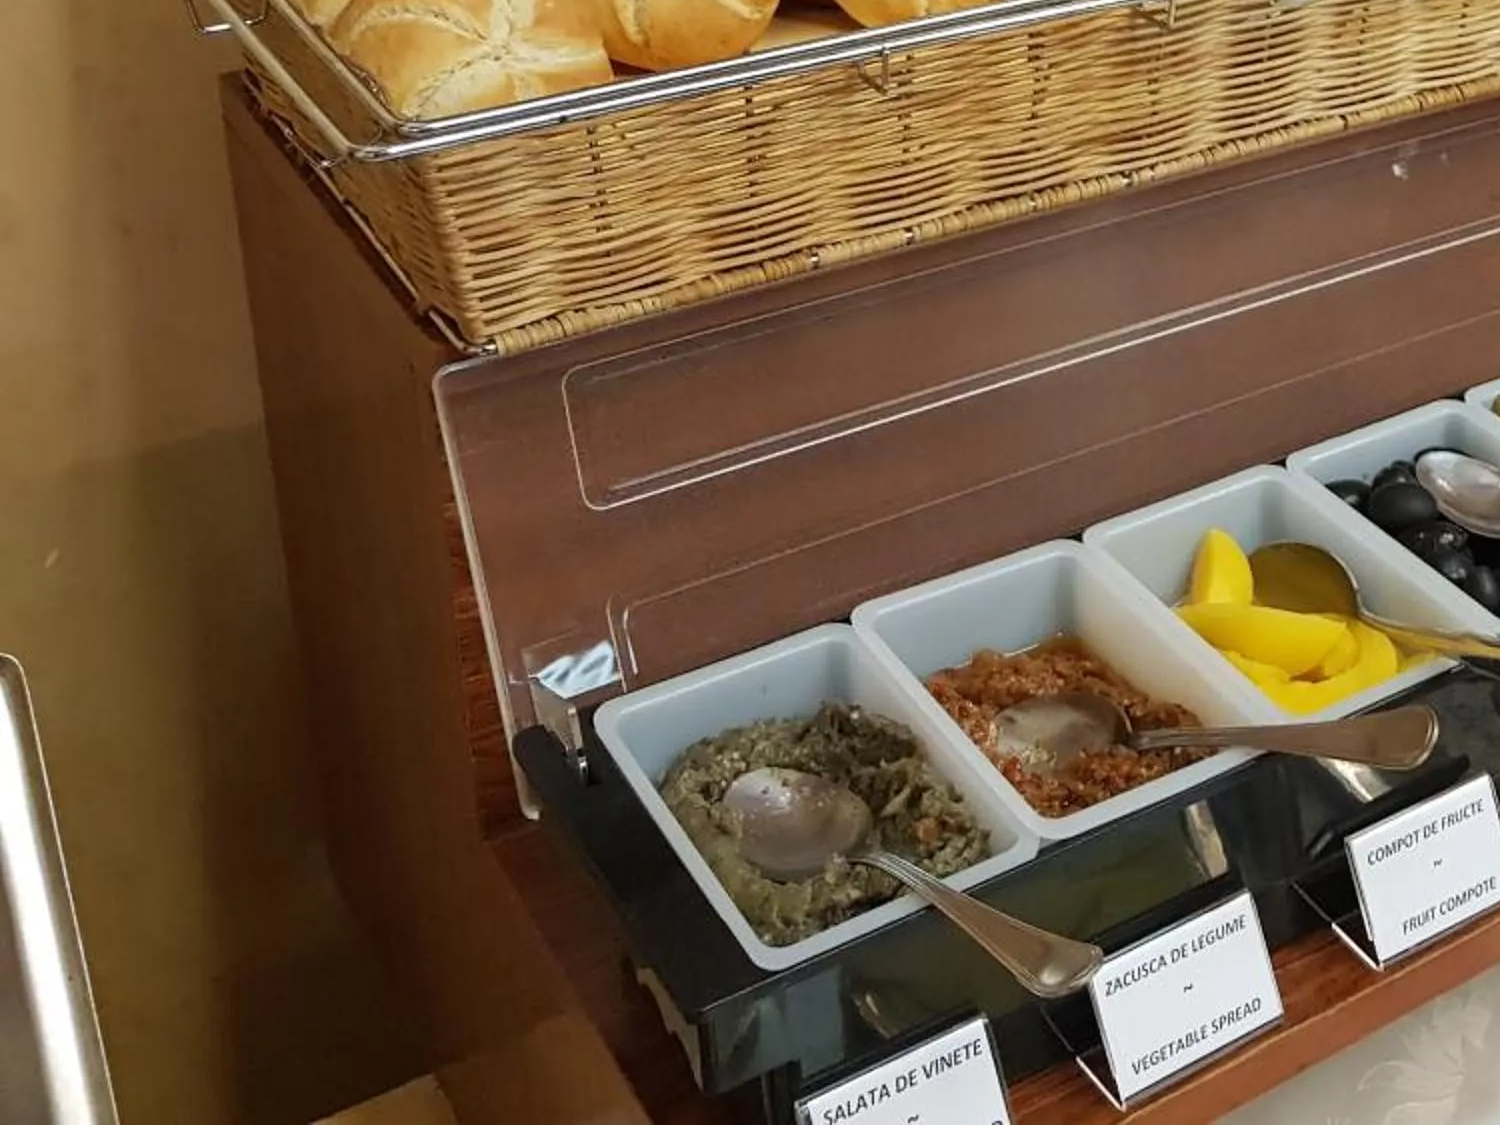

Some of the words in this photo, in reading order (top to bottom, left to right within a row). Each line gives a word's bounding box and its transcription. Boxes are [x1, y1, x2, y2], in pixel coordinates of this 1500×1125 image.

[1367, 830, 1421, 866] COMPOT
[1423, 821, 1440, 840] DE
[1441, 798, 1484, 831] FRUCTE
[1402, 906, 1437, 935] FRUIT
[1439, 876, 1497, 915] COMPOTE
[1105, 955, 1167, 996] ZACUSCA
[1171, 943, 1188, 963] DE
[1191, 914, 1247, 952] LEGUME
[1131, 1025, 1208, 1075] VEGETABLE
[1211, 997, 1262, 1034] SPREAD
[823, 1084, 891, 1125] SALATA
[895, 1069, 919, 1093] DE
[921, 1038, 983, 1080] VINETE
